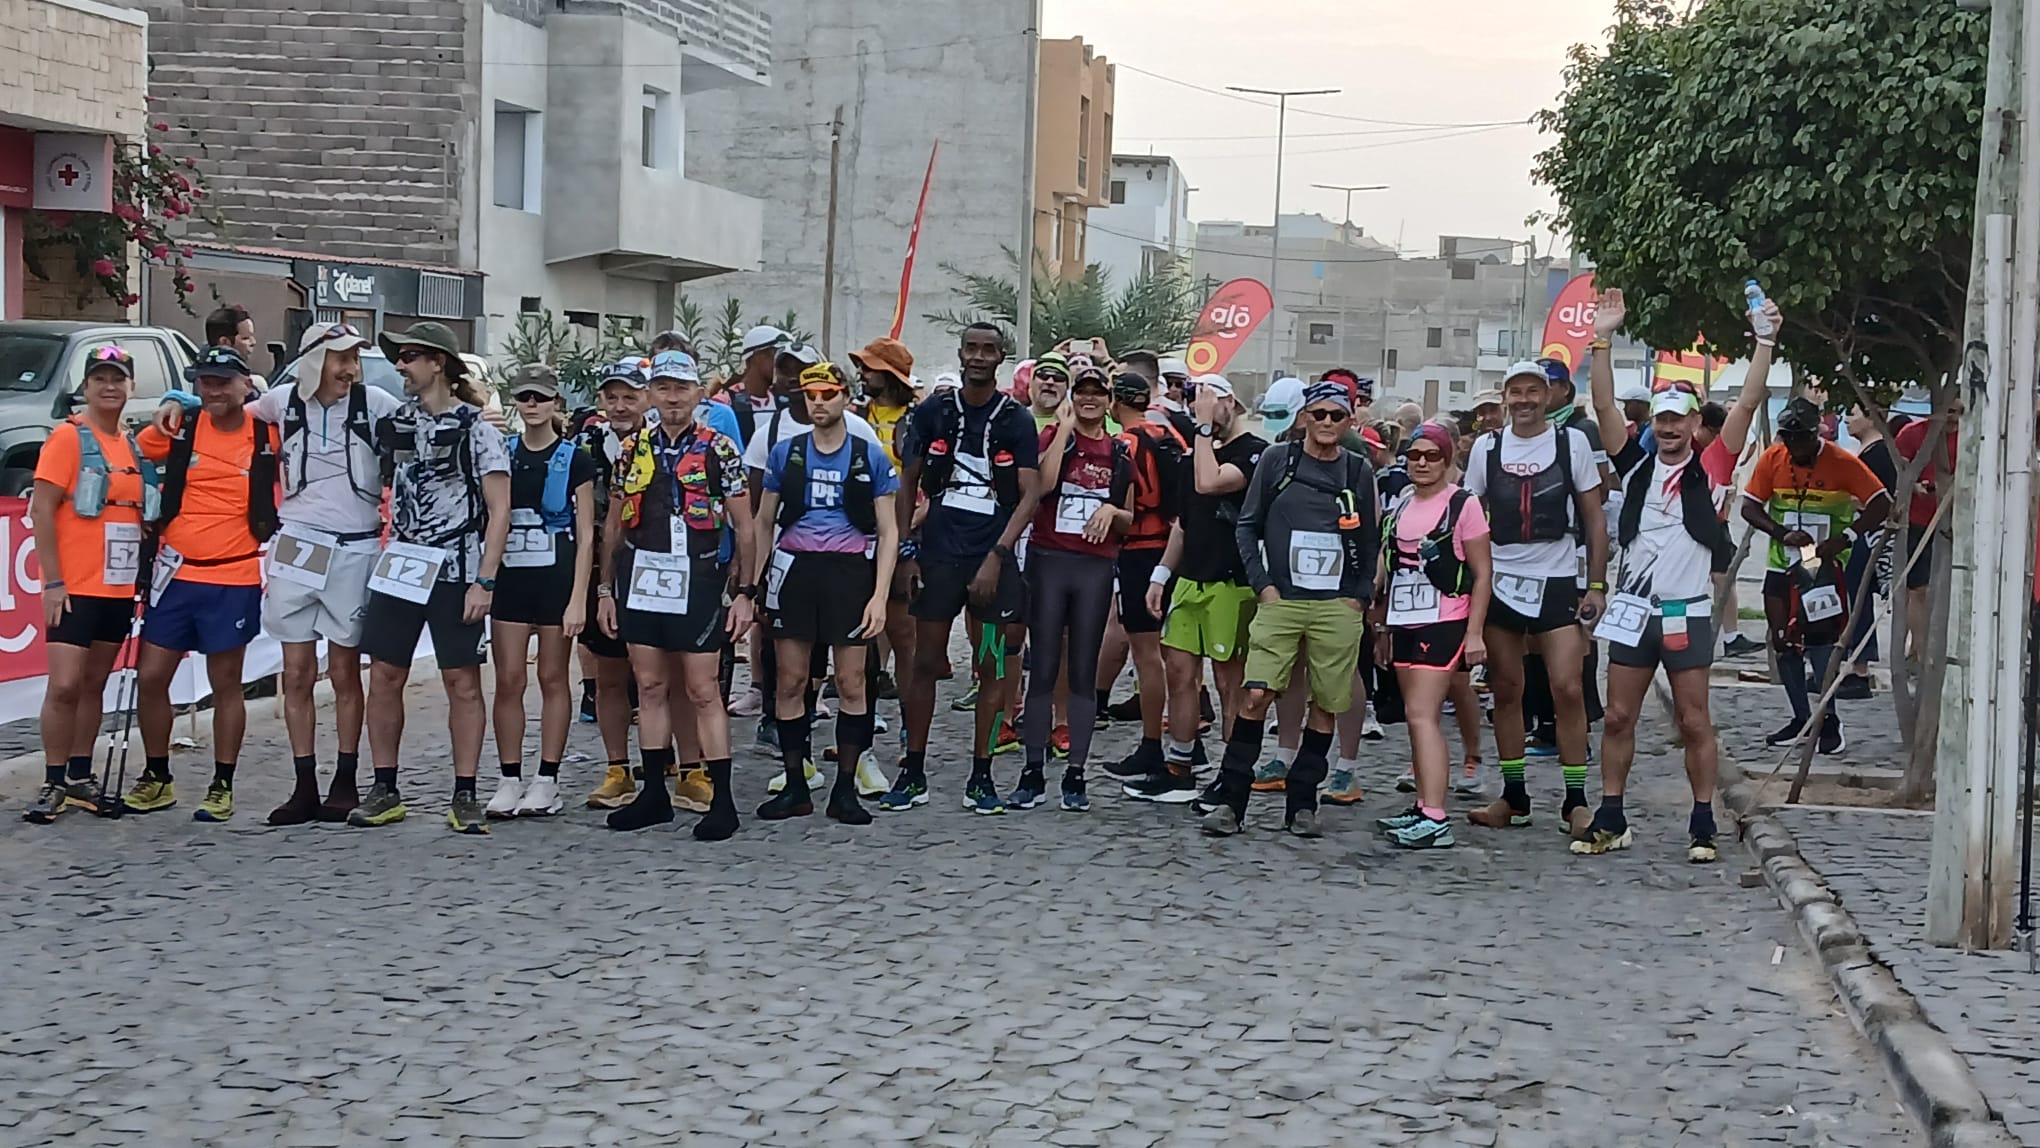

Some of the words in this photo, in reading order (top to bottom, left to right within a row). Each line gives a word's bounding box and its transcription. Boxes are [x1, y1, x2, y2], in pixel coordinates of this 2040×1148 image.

[292, 540, 315, 568] 7
[1297, 549, 1337, 575] 67
[387, 556, 428, 587] 12
[636, 569, 683, 599] 43
[1604, 601, 1646, 631] 35
